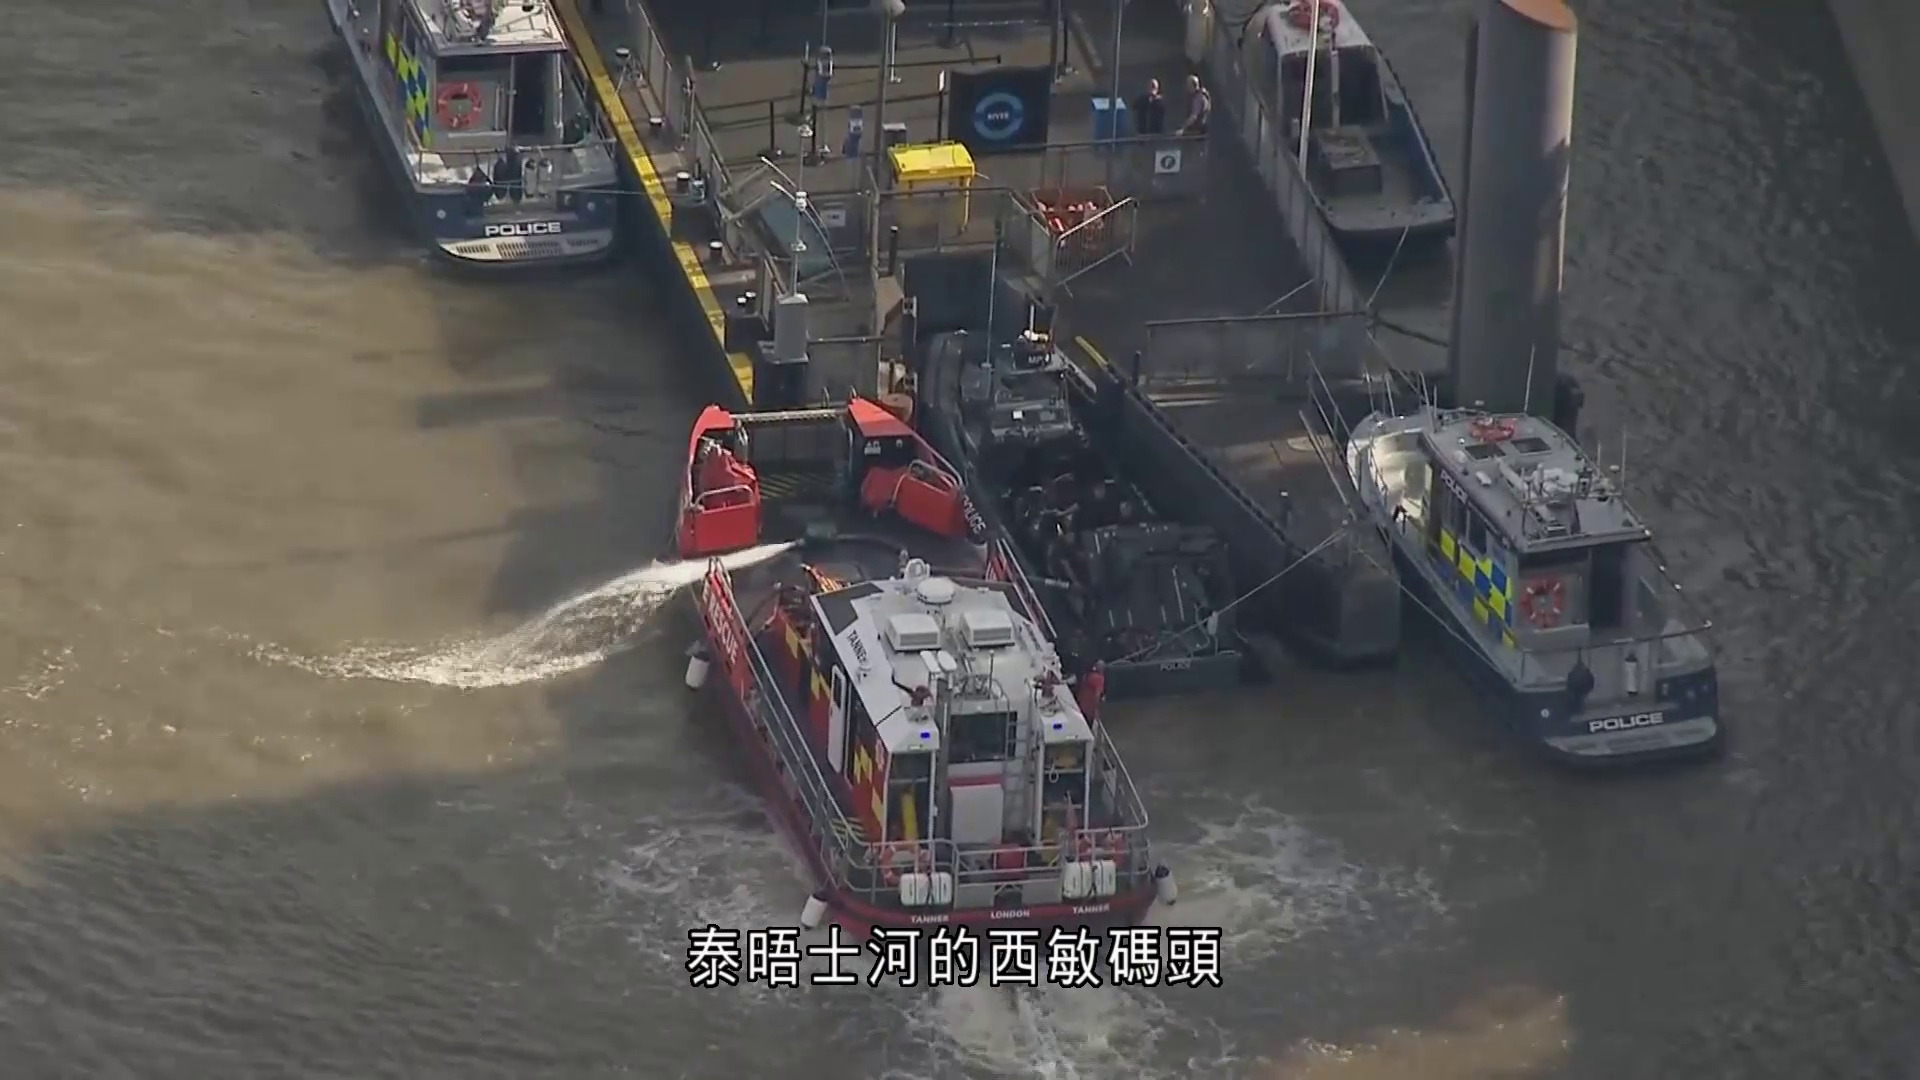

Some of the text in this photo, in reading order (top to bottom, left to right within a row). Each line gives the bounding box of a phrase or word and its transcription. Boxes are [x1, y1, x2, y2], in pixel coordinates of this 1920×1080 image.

[485, 222, 561, 237] POLICE
[1440, 469, 1468, 505] POLICE
[1589, 712, 1664, 733] POLICE
[911, 903, 1110, 924] TANNER LONDON TANNER
